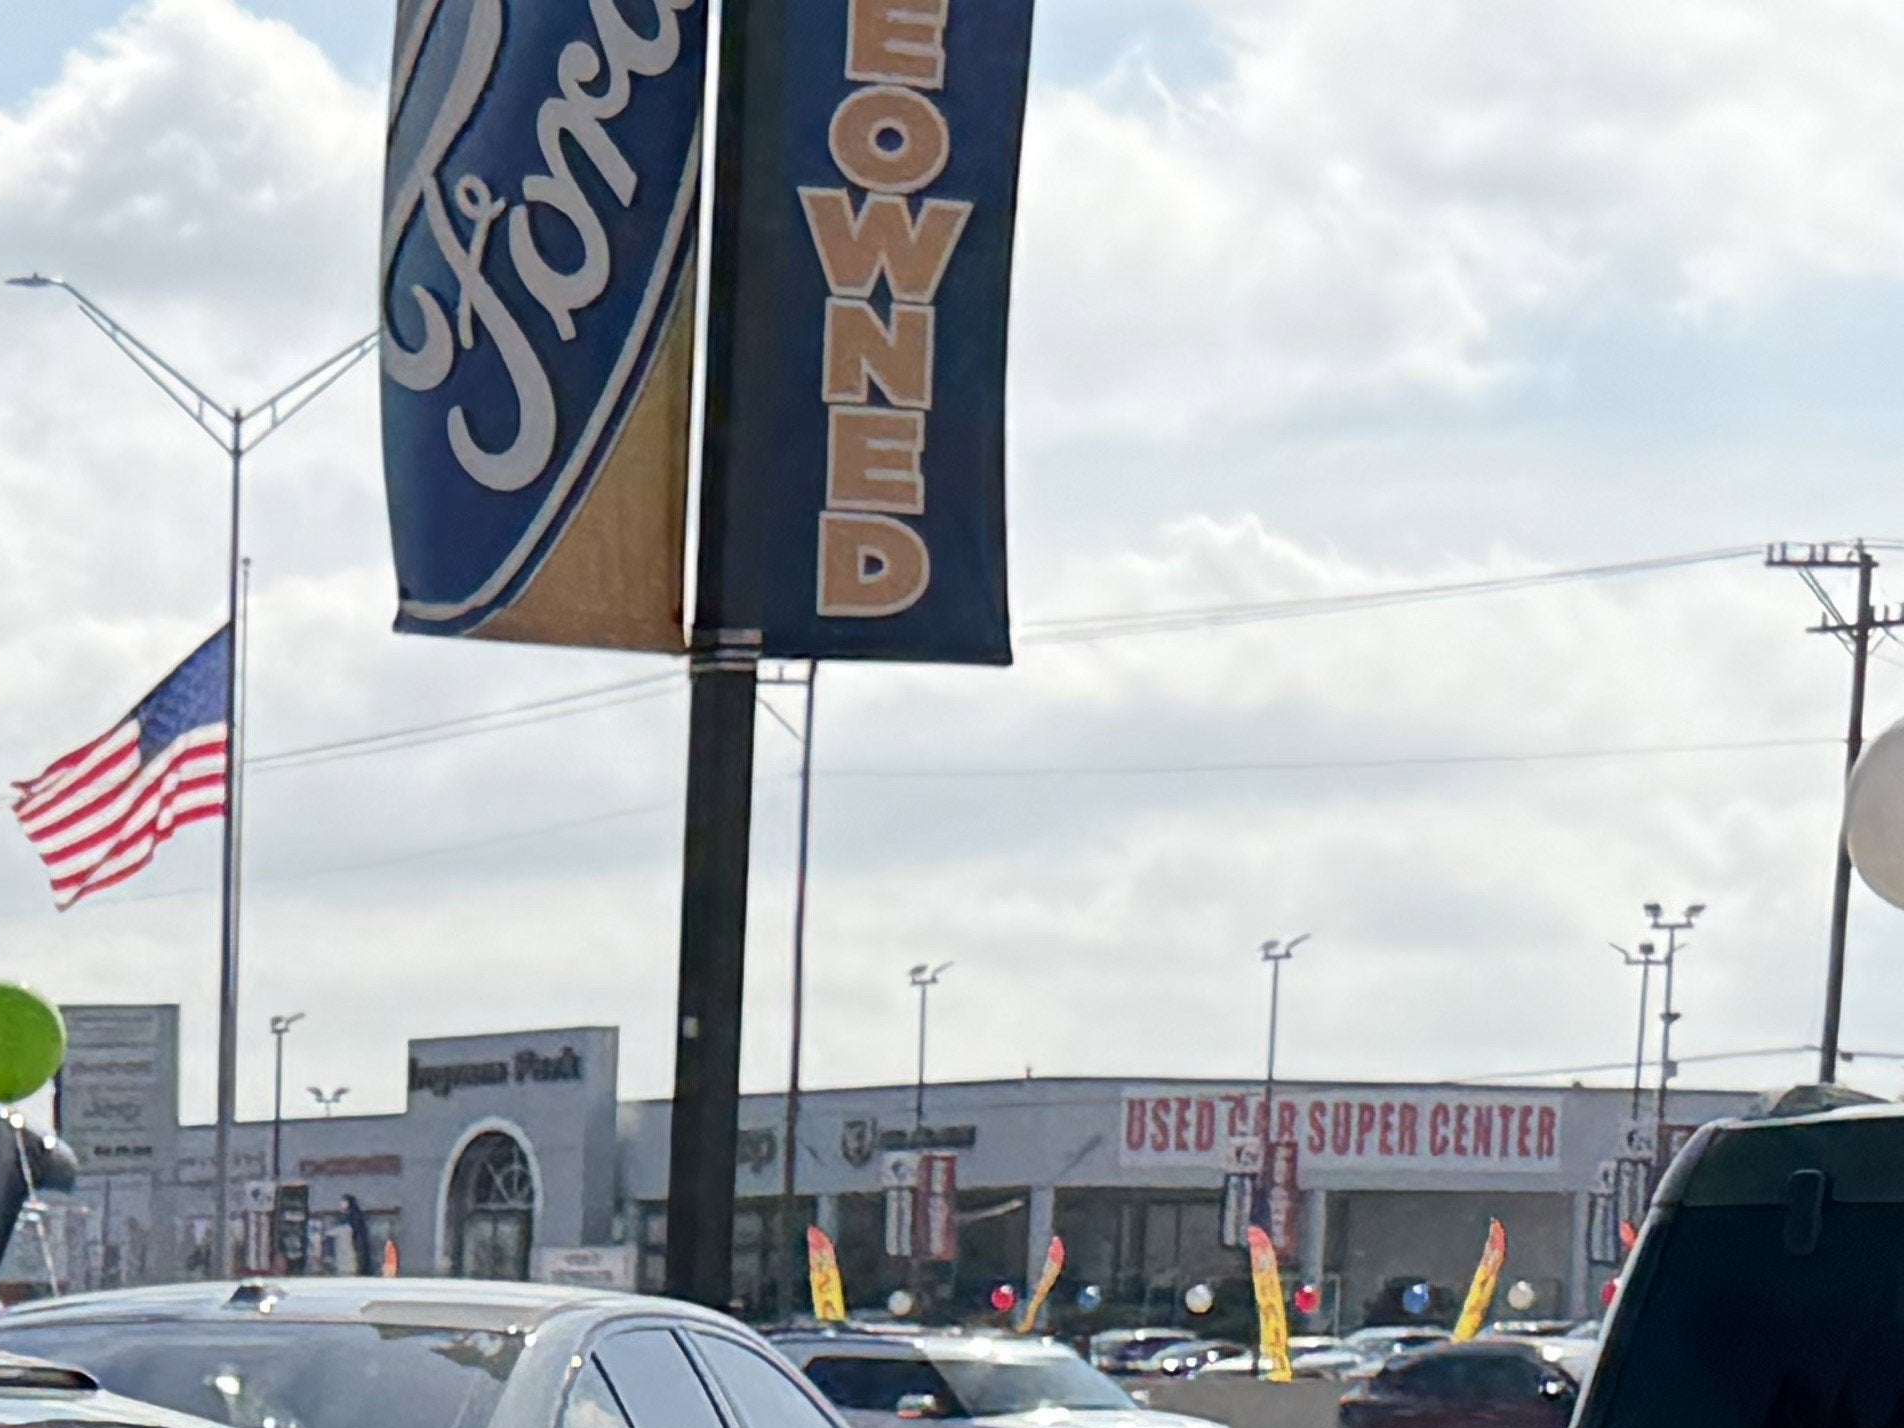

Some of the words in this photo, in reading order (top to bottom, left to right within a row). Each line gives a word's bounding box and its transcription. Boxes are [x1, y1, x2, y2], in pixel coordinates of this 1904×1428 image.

[1125, 1096, 1216, 1153] USED
[1307, 1100, 1418, 1155] SUPER
[1429, 1103, 1557, 1158] CENTER
